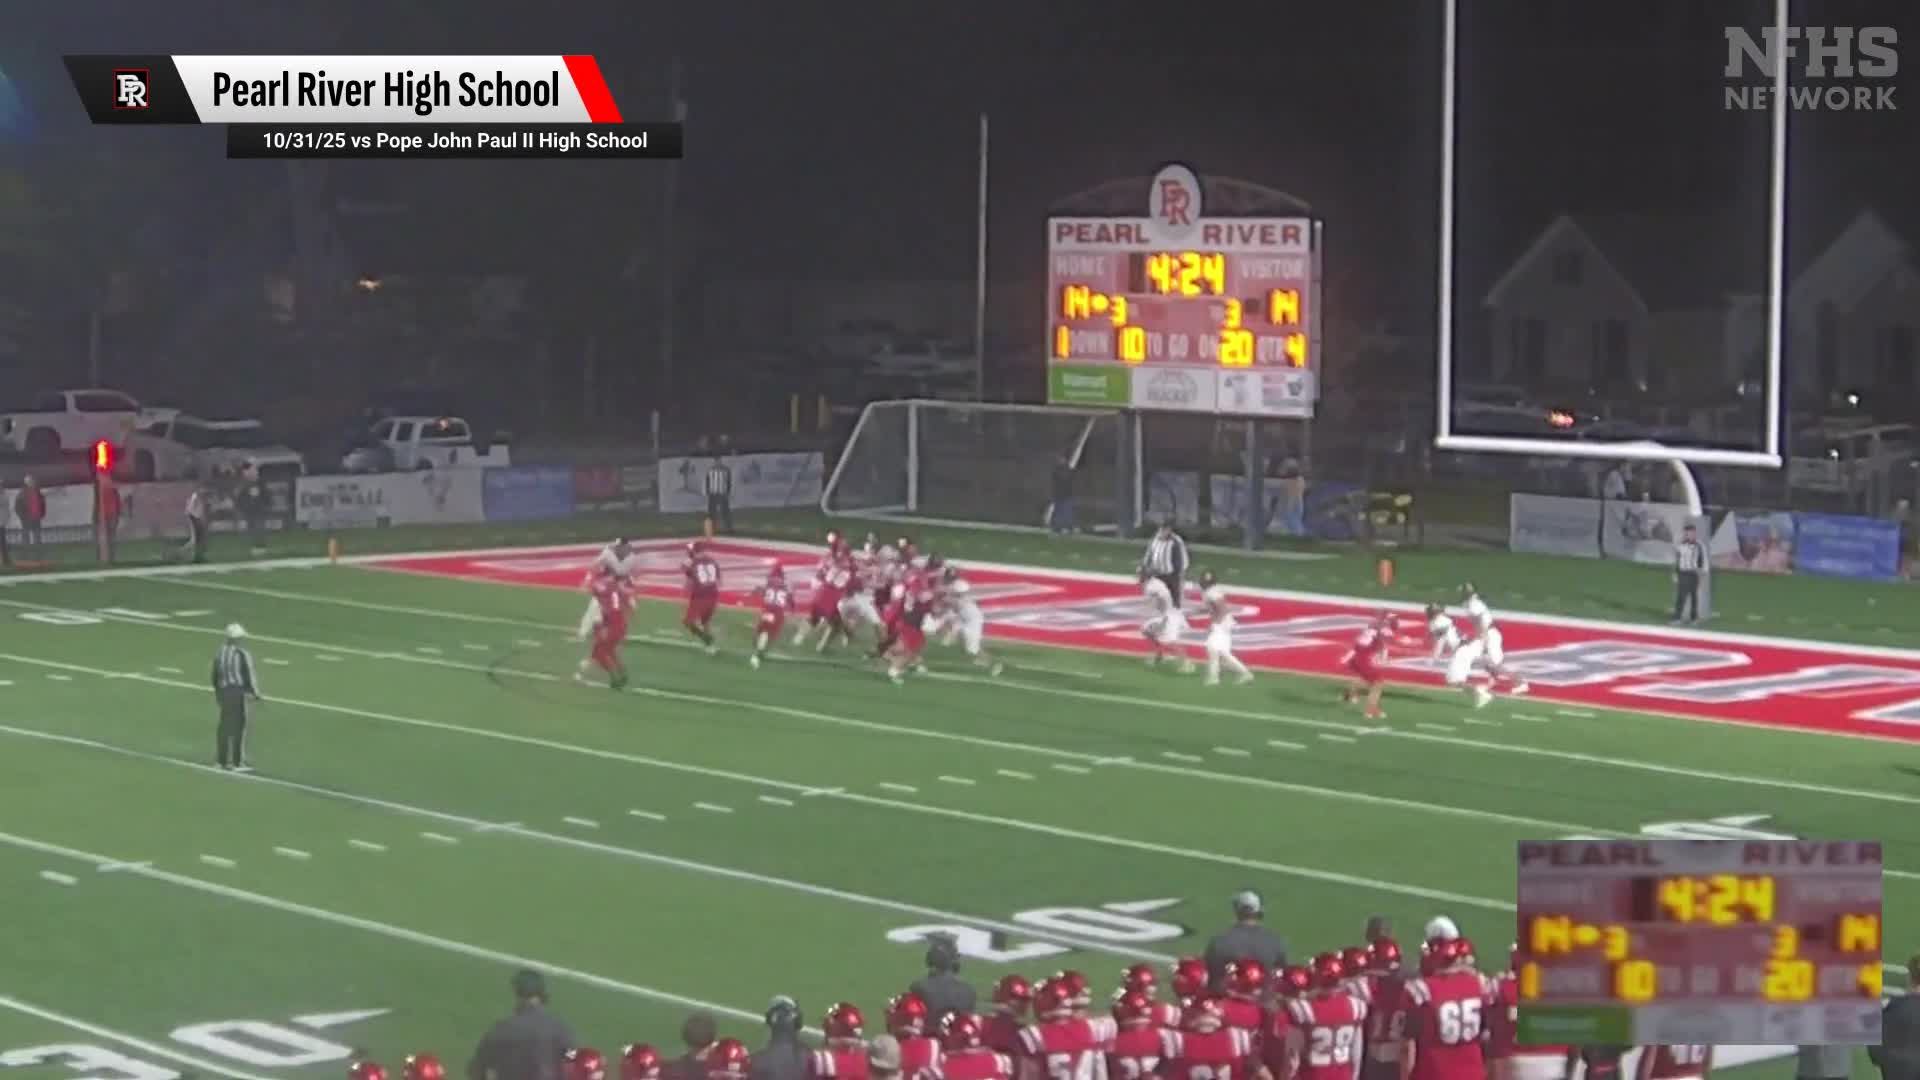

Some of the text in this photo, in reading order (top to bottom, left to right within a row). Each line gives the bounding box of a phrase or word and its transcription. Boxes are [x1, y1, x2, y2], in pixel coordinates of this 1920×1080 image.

[1056, 223, 1301, 245] PEARL RIVER
[1146, 252, 1225, 297] 4:24
[1218, 328, 1254, 369] 20
[1286, 333, 1306, 368] 4
[1439, 998, 1482, 1044] 65
